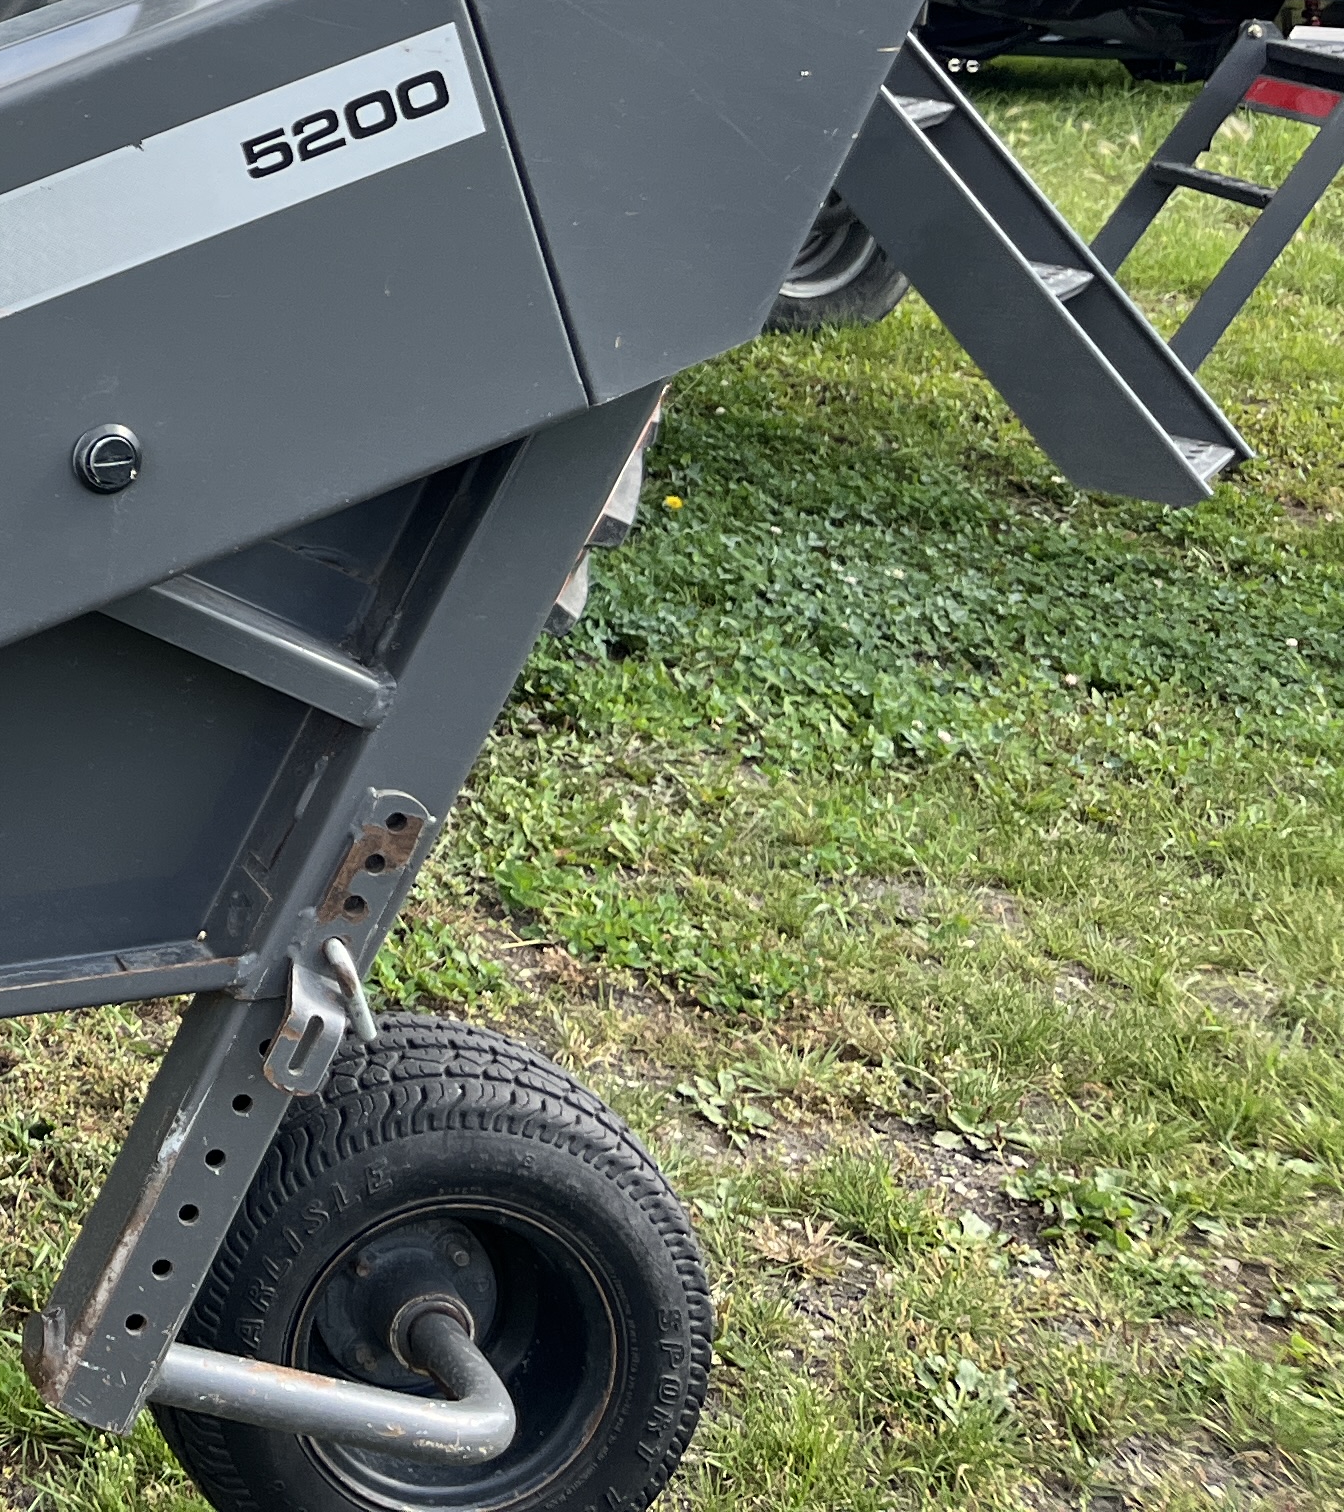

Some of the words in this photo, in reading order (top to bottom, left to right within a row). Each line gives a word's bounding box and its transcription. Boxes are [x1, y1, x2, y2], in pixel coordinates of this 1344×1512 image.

[240, 69, 450, 179] 5200
[233, 1155, 395, 1354] ARLISLE
[637, 1307, 686, 1472] SPORT
